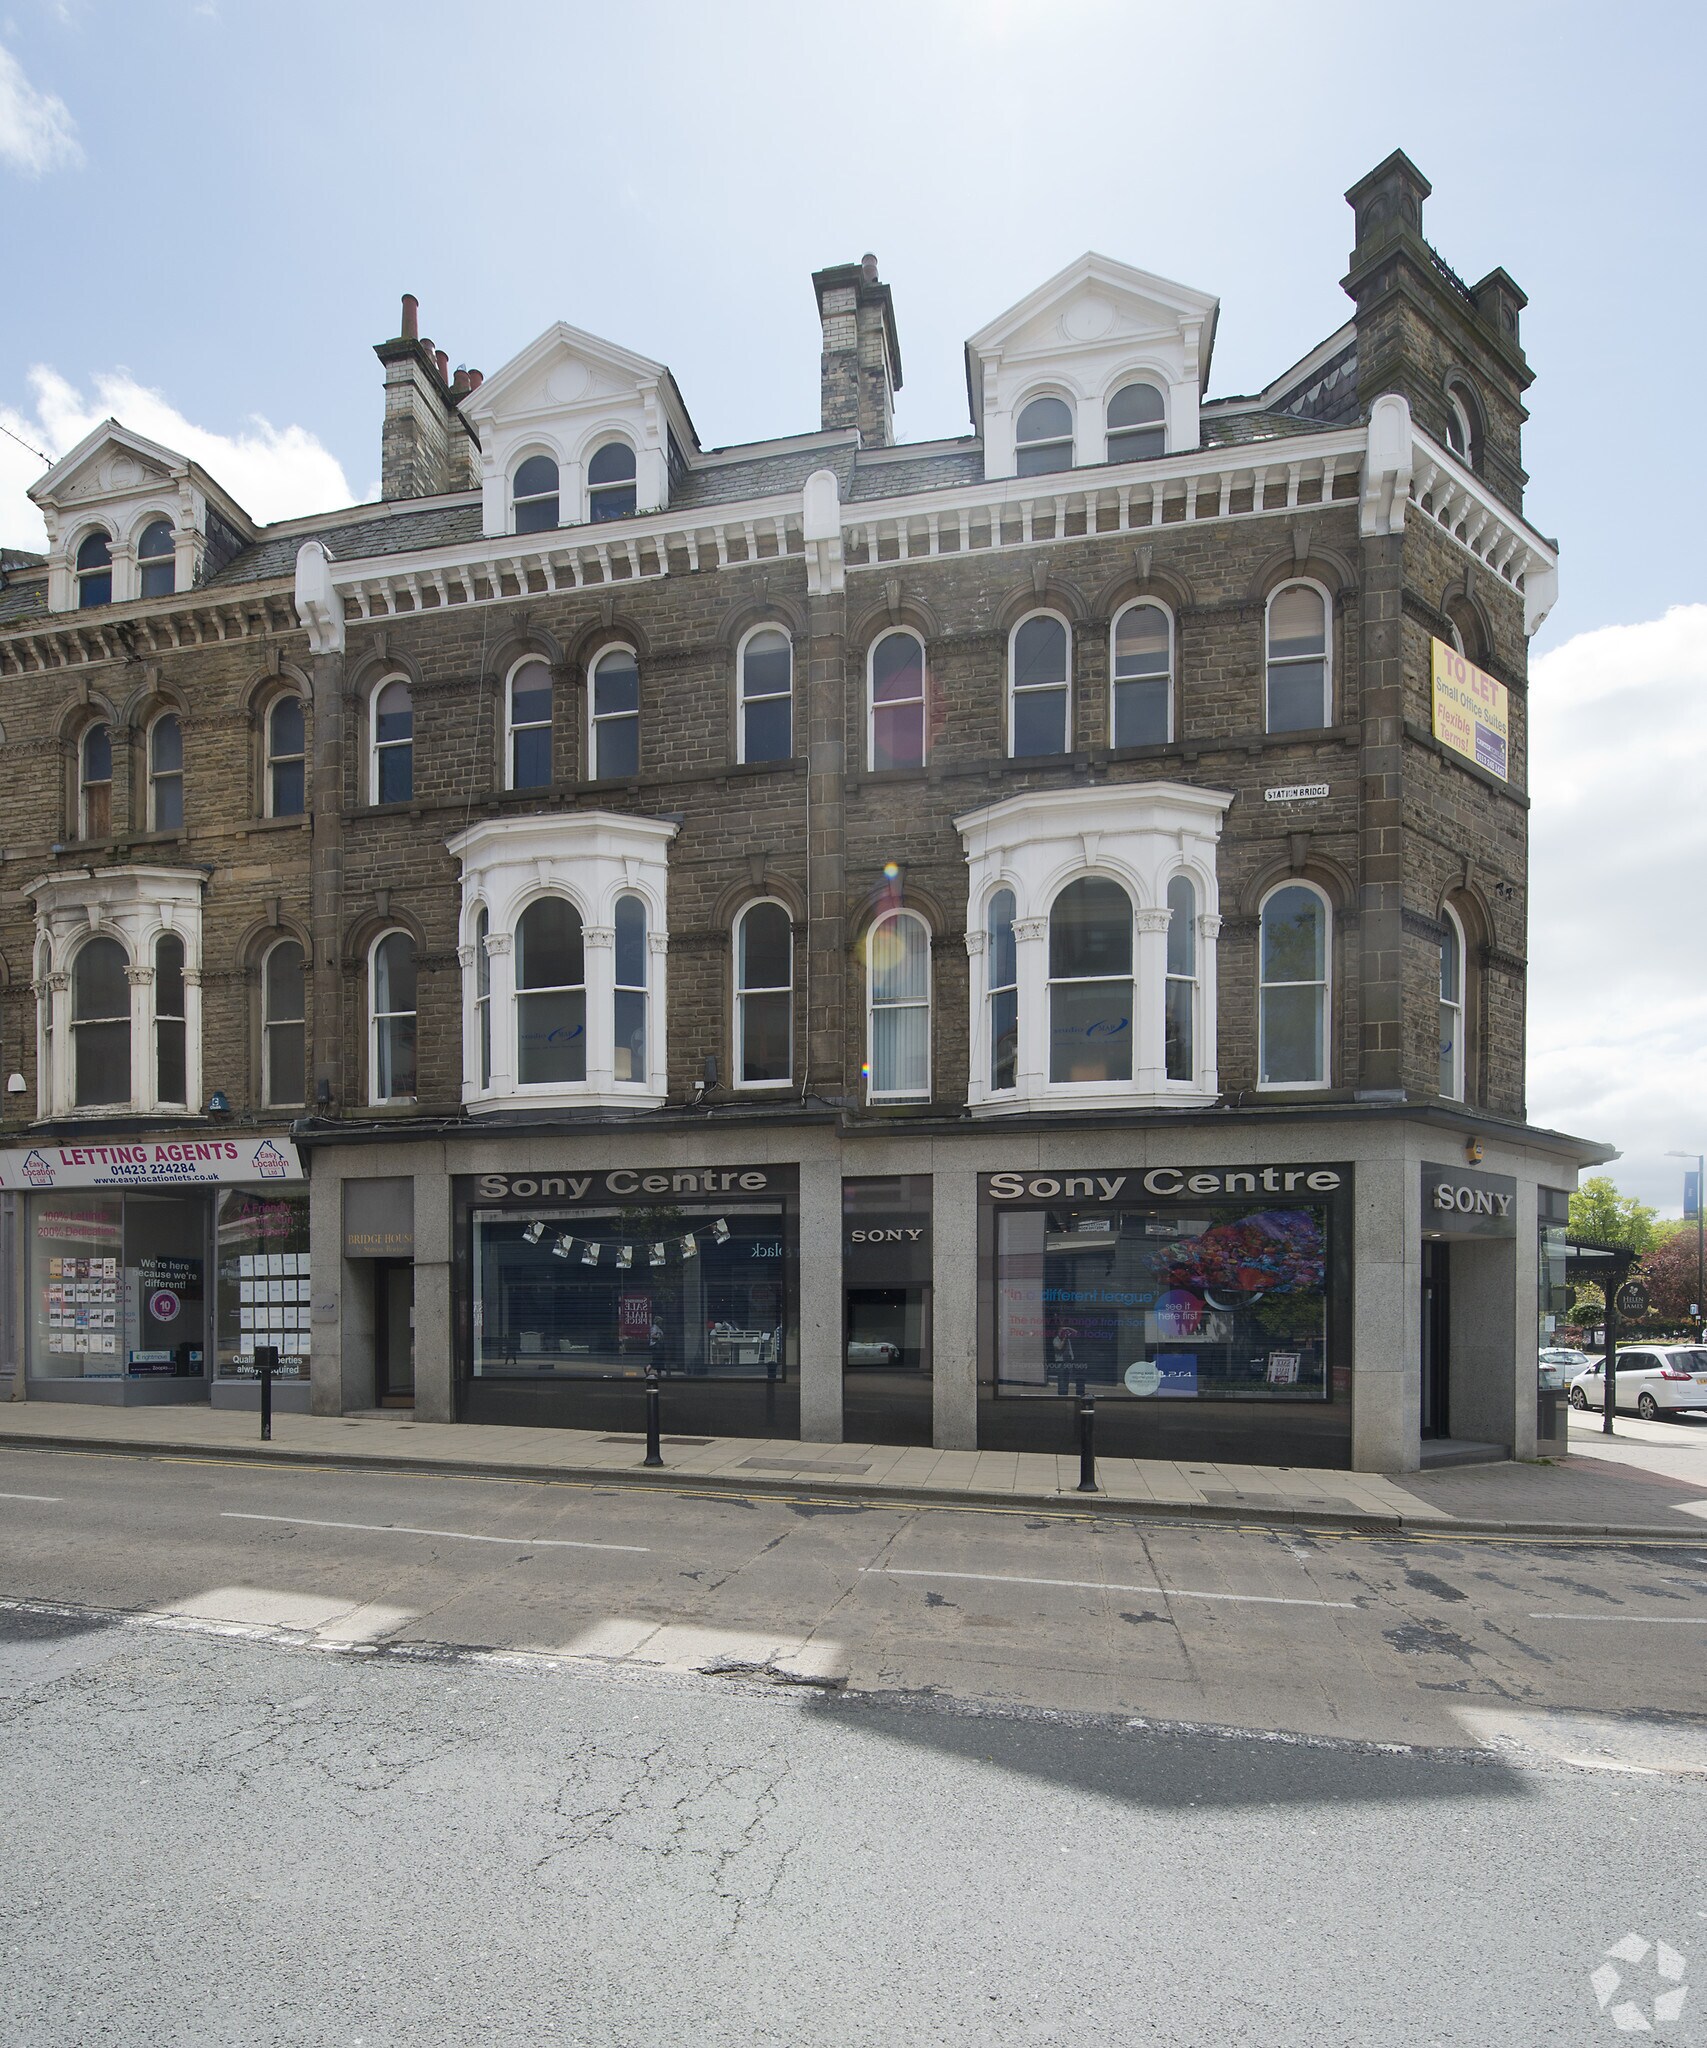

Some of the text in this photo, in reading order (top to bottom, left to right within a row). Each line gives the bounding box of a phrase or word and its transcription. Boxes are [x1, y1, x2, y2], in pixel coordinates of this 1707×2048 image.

[1444, 648, 1498, 706] TO LET
[1436, 676, 1459, 703] Small
[1460, 692, 1483, 718] Office
[1484, 709, 1507, 735] Suites
[1438, 703, 1471, 736] Flexible
[1440, 723, 1469, 752] Terms!
[59, 1142, 238, 1166] LETTING AGENTS
[260, 1151, 276, 1159] Easy
[28, 1160, 44, 1168] Easy
[111, 1162, 196, 1176] 01423 224284
[252, 1158, 289, 1168] Location
[22, 1168, 56, 1177] Location
[93, 1172, 220, 1184] www.easylocationlets.co.uk
[479, 1169, 768, 1200] Sony Centre
[988, 1166, 1342, 1201] Sony Centre
[1434, 1183, 1514, 1217] SONY
[38, 1226, 64, 1237] 200%
[851, 1228, 923, 1242] SONY
[348, 1234, 382, 1244] BRIDGE
[141, 1258, 190, 1270] We're here
[132, 1268, 198, 1280] because we're
[144, 1278, 187, 1289] different!
[1040, 1287, 1099, 1301] different
[160, 1300, 171, 1310] 10
[1165, 1301, 1191, 1311] see it
[1158, 1311, 1199, 1321] here first
[1084, 1328, 1114, 1340] today
[1168, 1370, 1192, 1378] PS4
